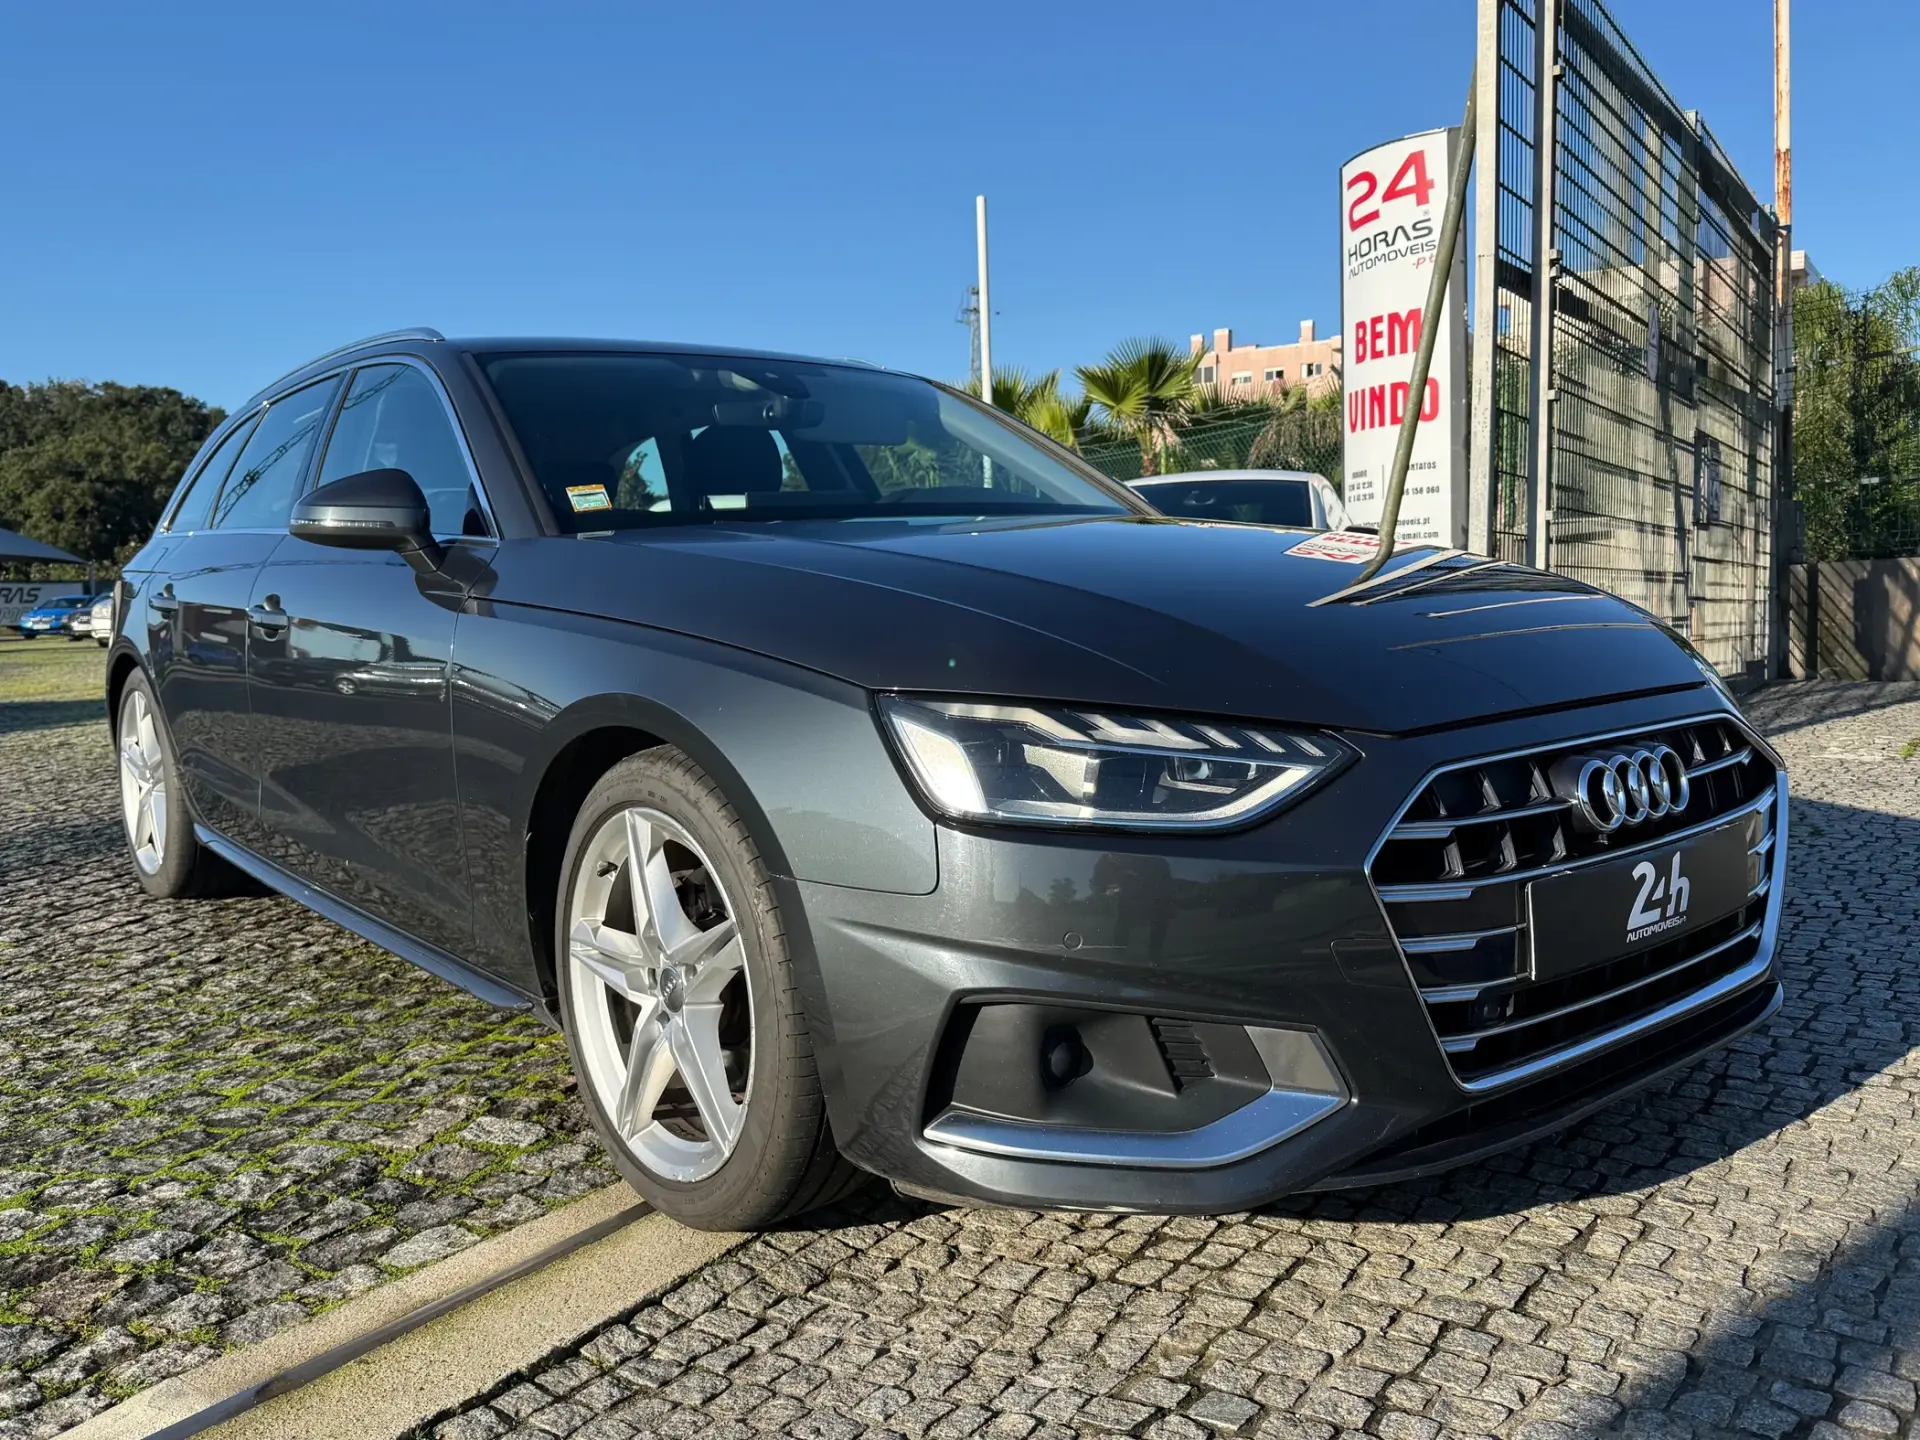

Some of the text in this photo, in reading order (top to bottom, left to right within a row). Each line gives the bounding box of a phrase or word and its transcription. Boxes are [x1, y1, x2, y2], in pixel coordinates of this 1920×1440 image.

[1347, 150, 1435, 232] 24
[1348, 218, 1434, 266] HORAS
[1348, 240, 1437, 279] AUTOMOVEIS
[1355, 308, 1422, 364] BEM
[1349, 377, 1440, 433] VINDO
